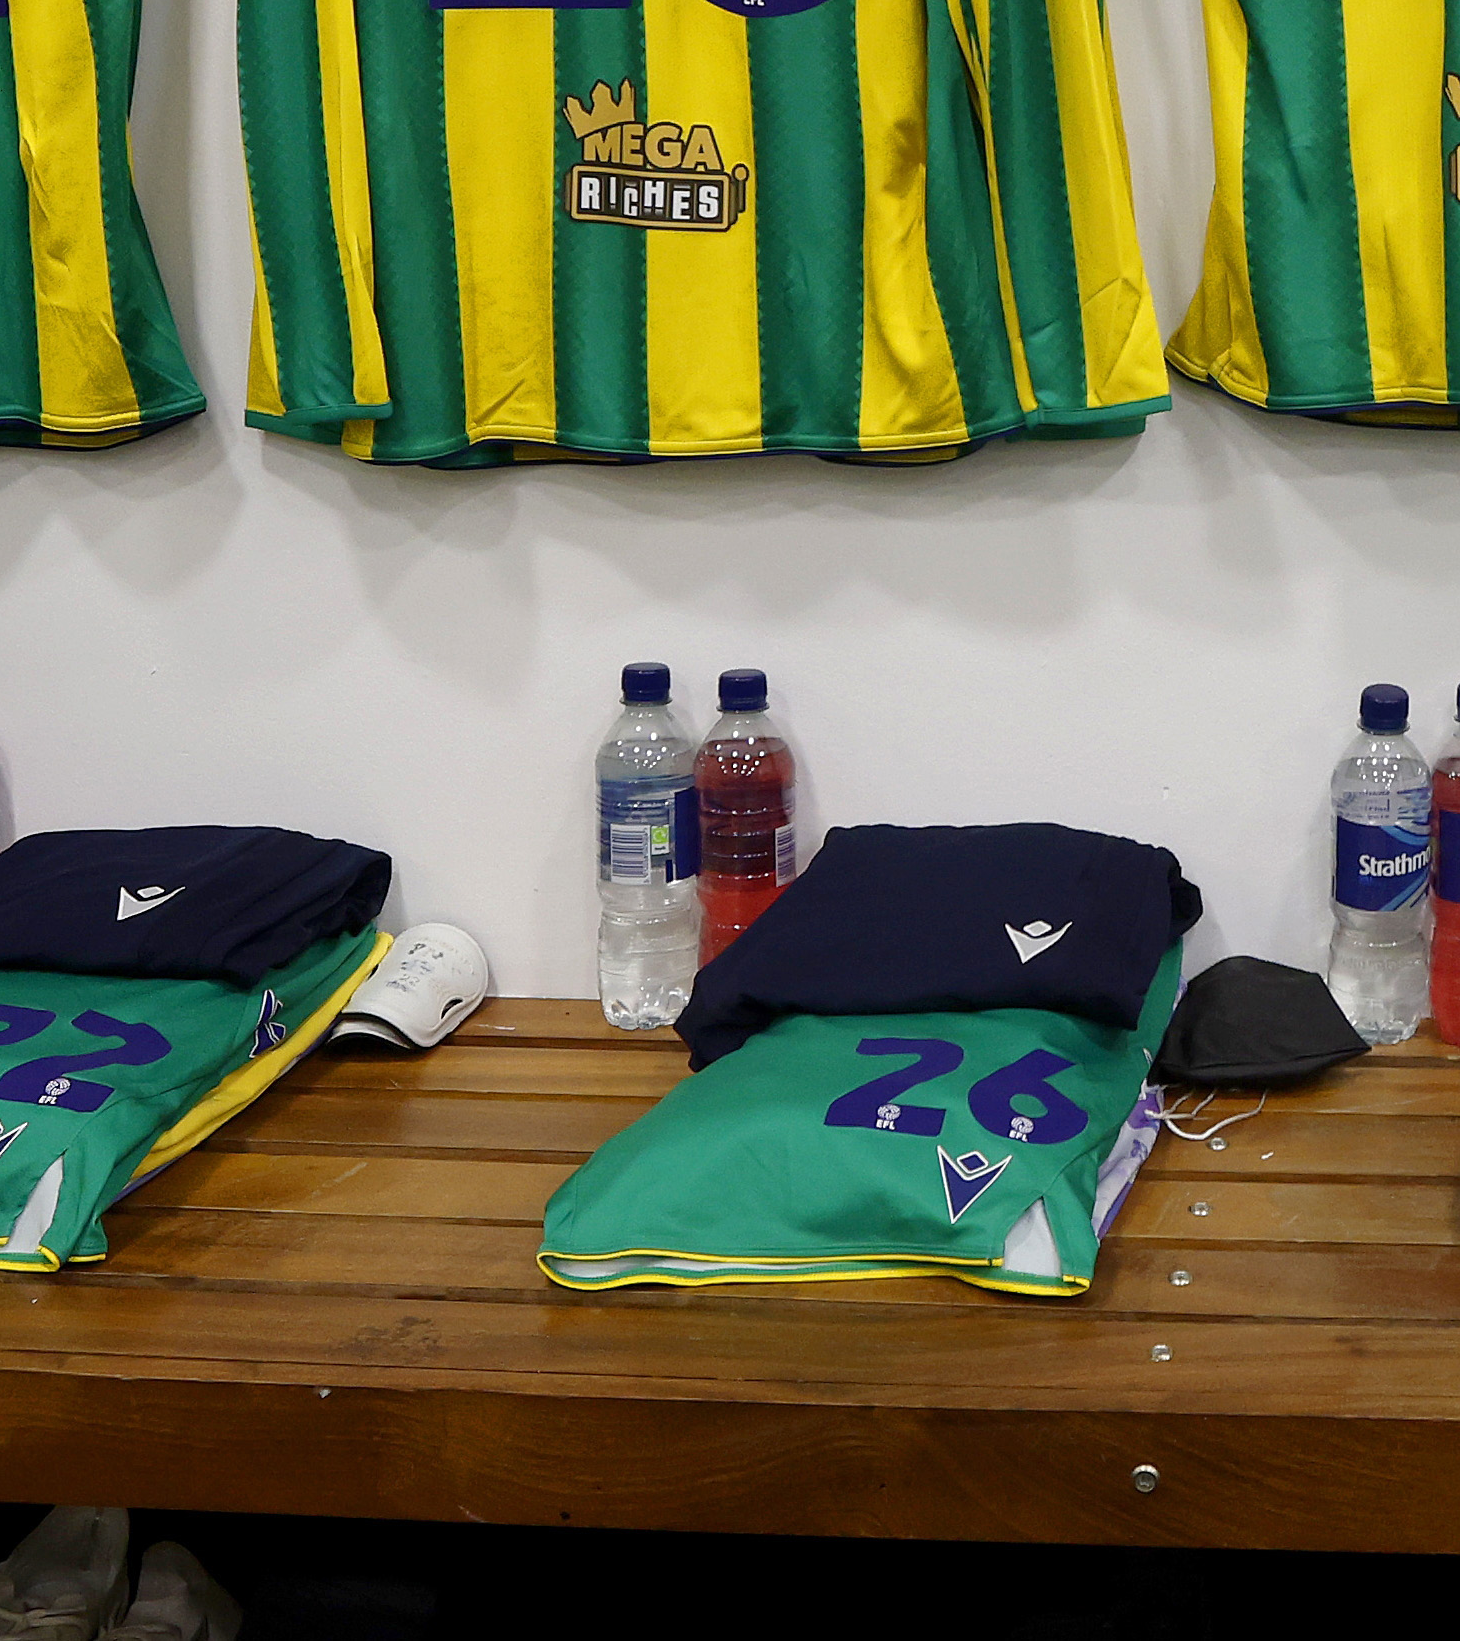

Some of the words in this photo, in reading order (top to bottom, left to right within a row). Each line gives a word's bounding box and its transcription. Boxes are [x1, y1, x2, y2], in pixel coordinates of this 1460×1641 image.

[583, 124, 721, 171] MEGA
[580, 176, 719, 221] RICHES
[38, 1095, 57, 1105] EFL
[823, 1037, 1089, 1145] 26
[876, 1118, 896, 1130] EFL
[1009, 1129, 1028, 1142] EFL
